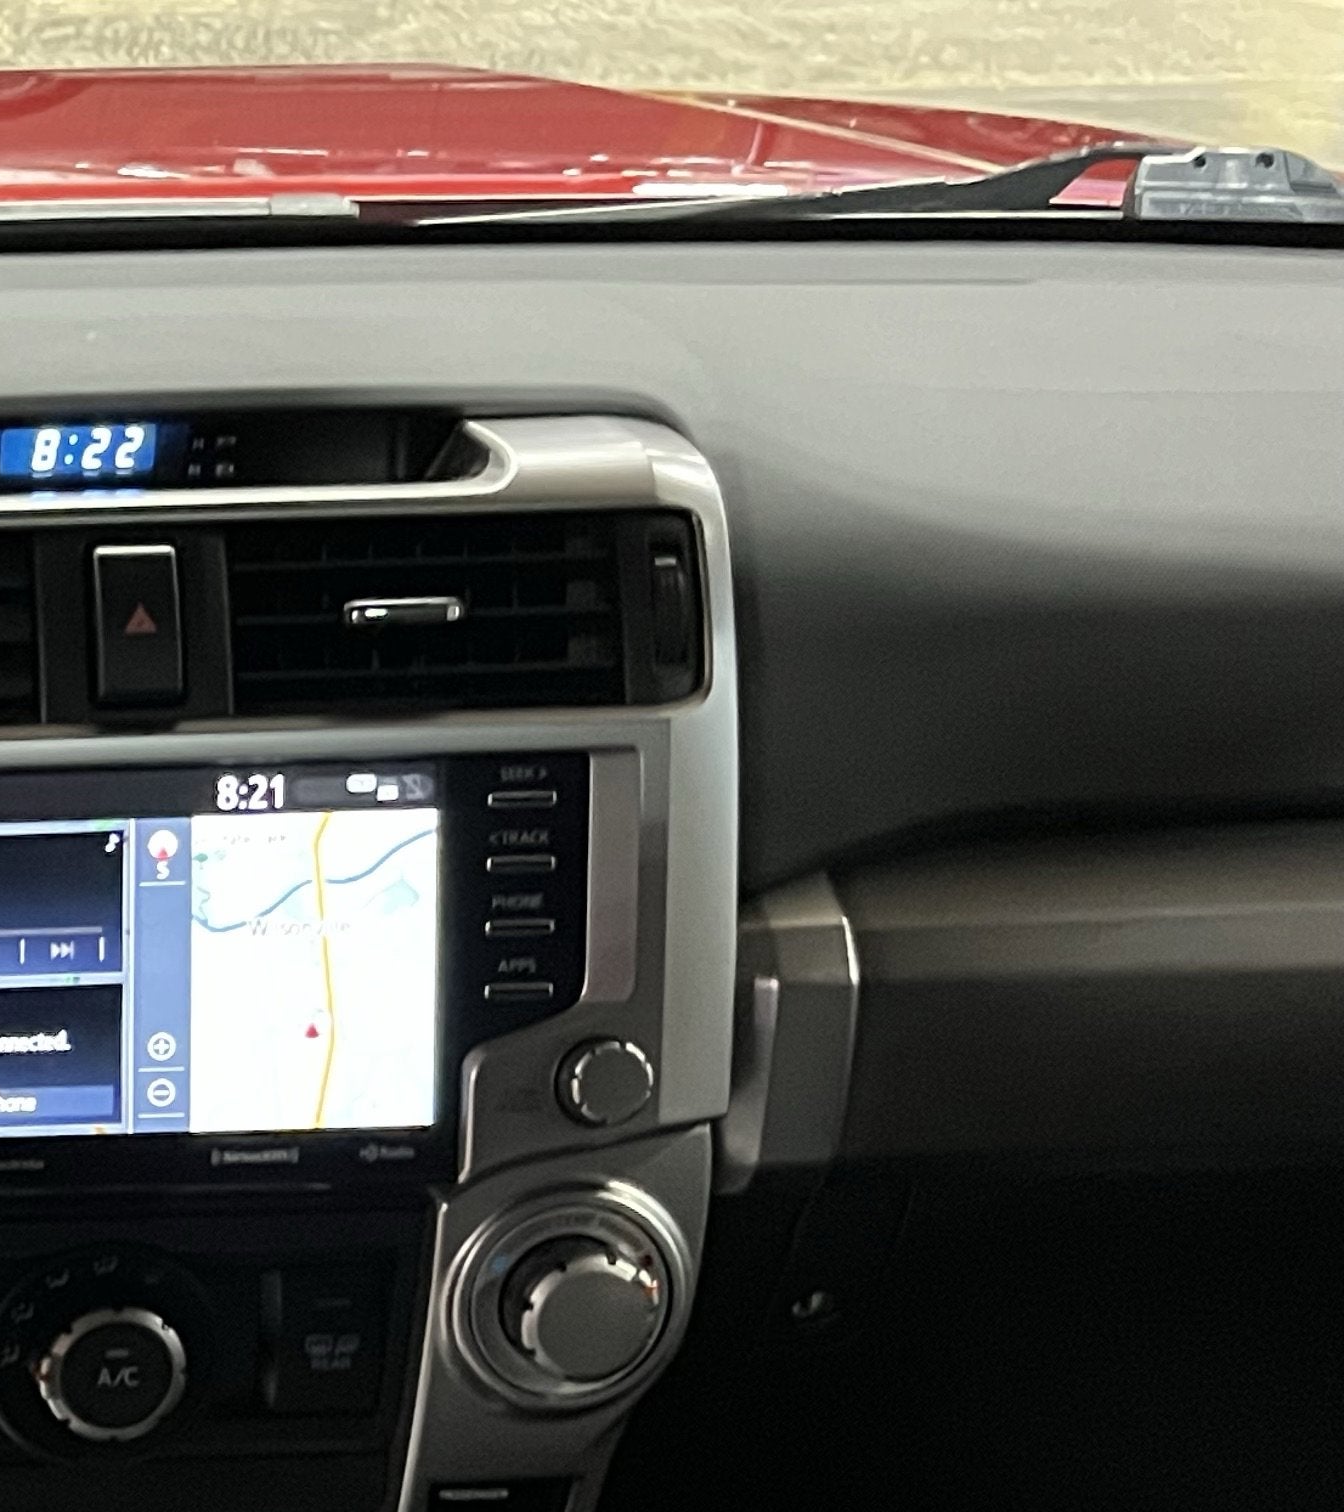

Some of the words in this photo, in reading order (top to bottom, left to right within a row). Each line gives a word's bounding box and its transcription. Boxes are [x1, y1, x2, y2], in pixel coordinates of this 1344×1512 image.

[31, 426, 145, 472] 8:22
[216, 773, 285, 811] 8:21
[96, 1367, 141, 1388] A/C
